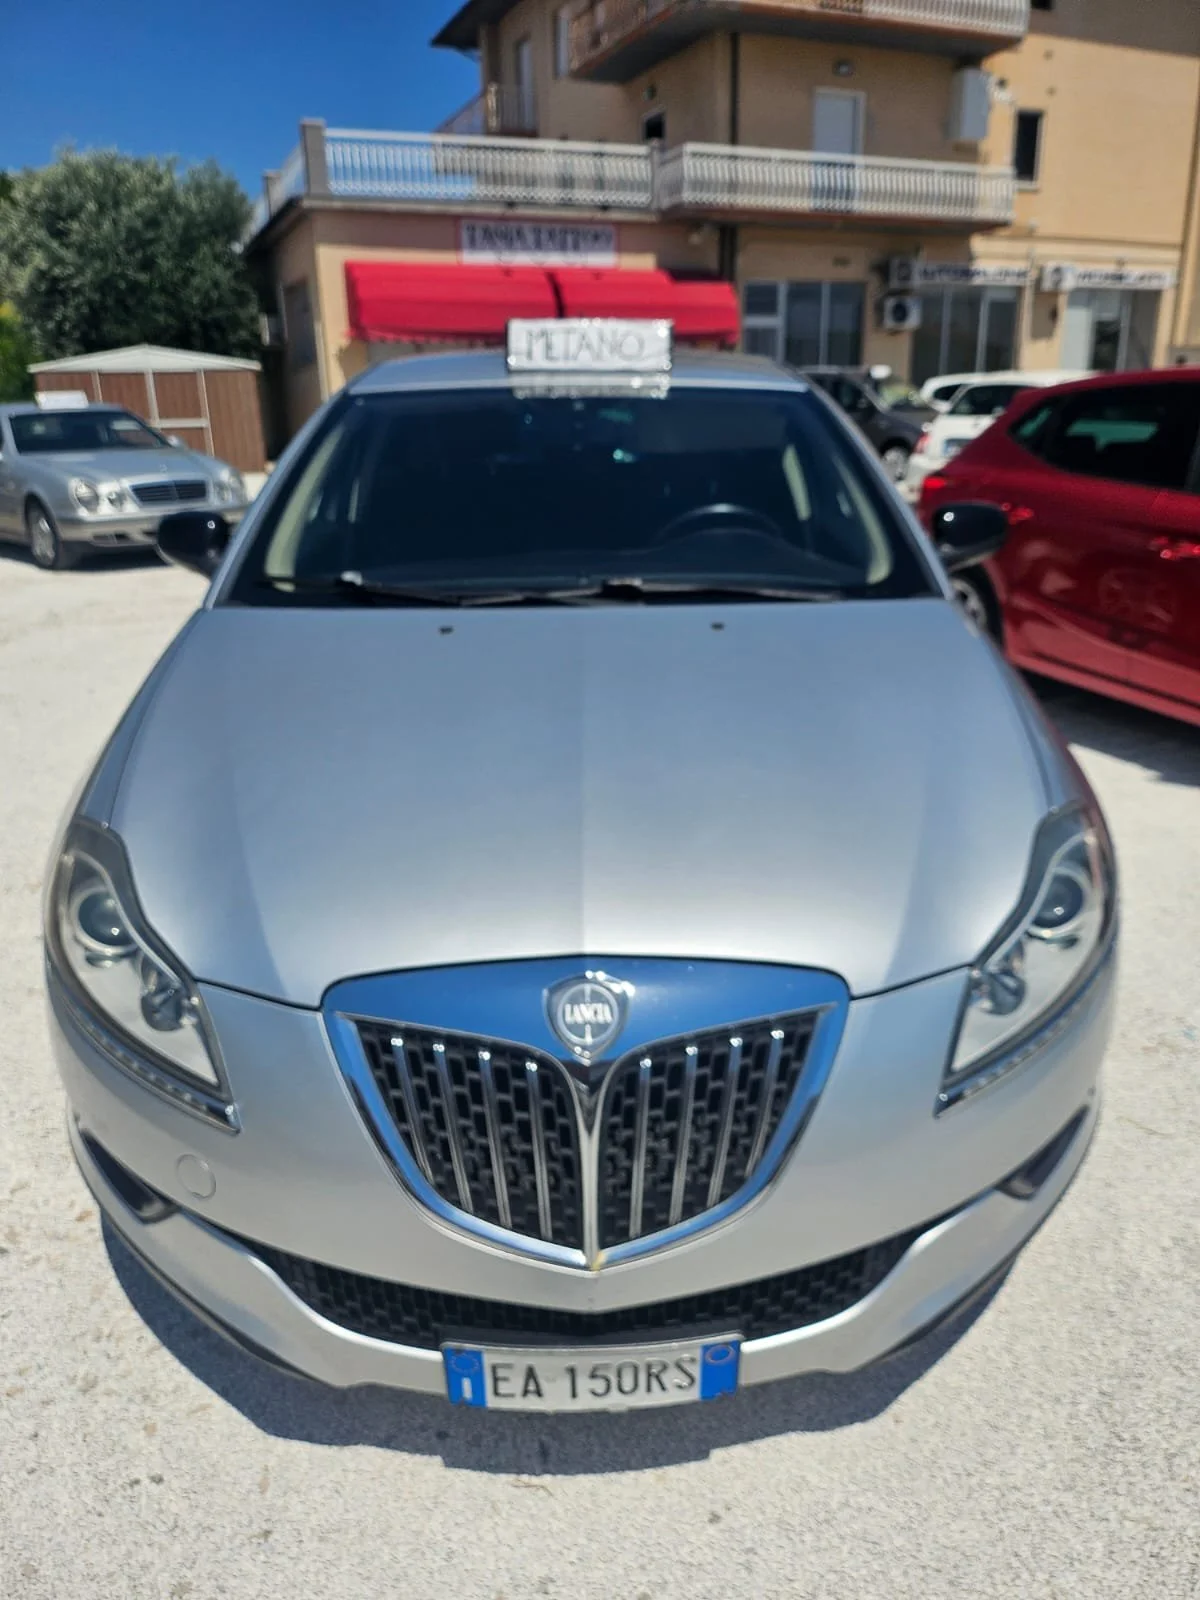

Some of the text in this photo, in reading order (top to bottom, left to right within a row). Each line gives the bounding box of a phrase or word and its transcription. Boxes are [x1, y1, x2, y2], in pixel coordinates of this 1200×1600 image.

[564, 1002, 612, 1025] LANCIA
[490, 1354, 697, 1399] EA 150RS
